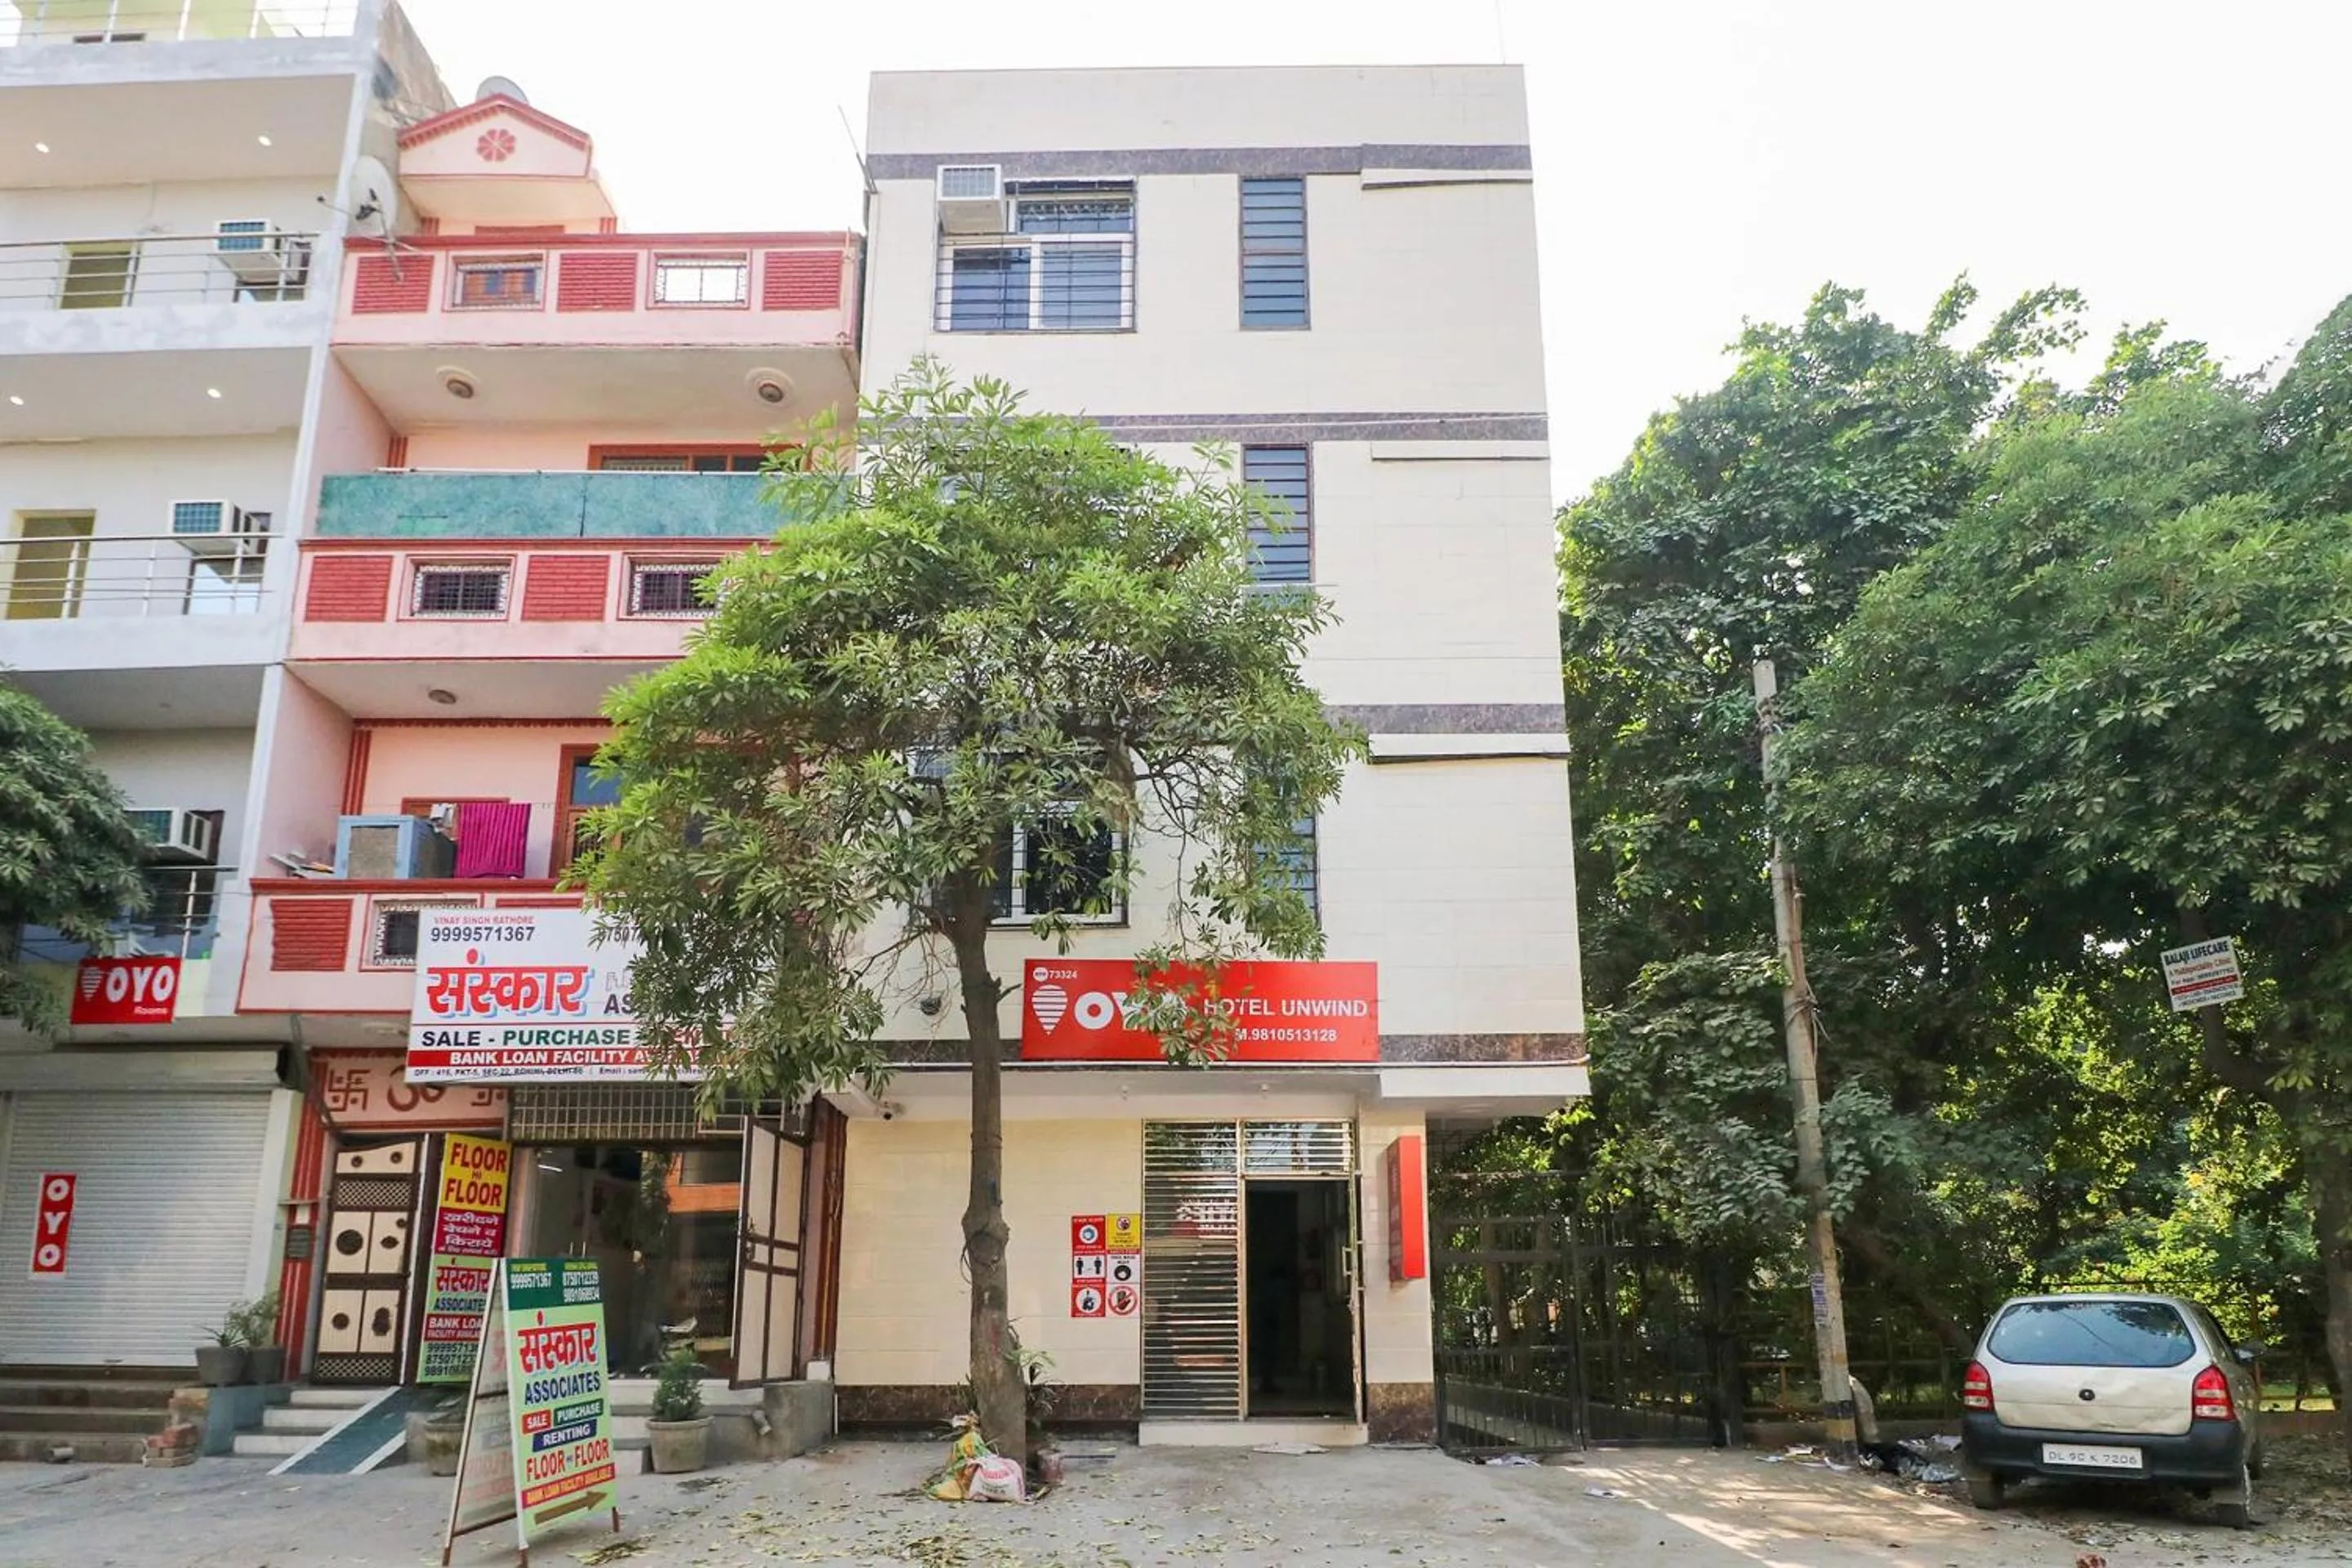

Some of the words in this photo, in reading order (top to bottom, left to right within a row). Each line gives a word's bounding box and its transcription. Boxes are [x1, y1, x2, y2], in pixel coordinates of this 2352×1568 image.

[430, 926, 536, 942] 9999571367
[434, 916, 459, 924] VINAY
[463, 916, 490, 924] SINGH
[105, 965, 176, 1003] OYO
[426, 947, 593, 1018] संस्कार
[1204, 999, 1275, 1017] HOTEL
[1281, 1000, 1368, 1017] UNWIND
[421, 1031, 481, 1047] SALE
[503, 1029, 630, 1046] PURCHASE
[450, 1051, 497, 1066] BANK
[502, 1050, 548, 1065] LOAN
[553, 1049, 627, 1064] FACILITY
[450, 1142, 507, 1173] FLOOR
[444, 1178, 502, 1207] FLOOR
[38, 1178, 69, 1267] OYO
[429, 1317, 460, 1329] BANK
[517, 1310, 599, 1374] संस्कार
[524, 1371, 601, 1405] ASSOCIATES
[527, 1414, 548, 1430] SALE
[557, 1403, 601, 1423] PURCHASE
[542, 1423, 590, 1446] RENTING
[526, 1450, 566, 1482] FLOOR
[574, 1437, 609, 1468] FLOOR
